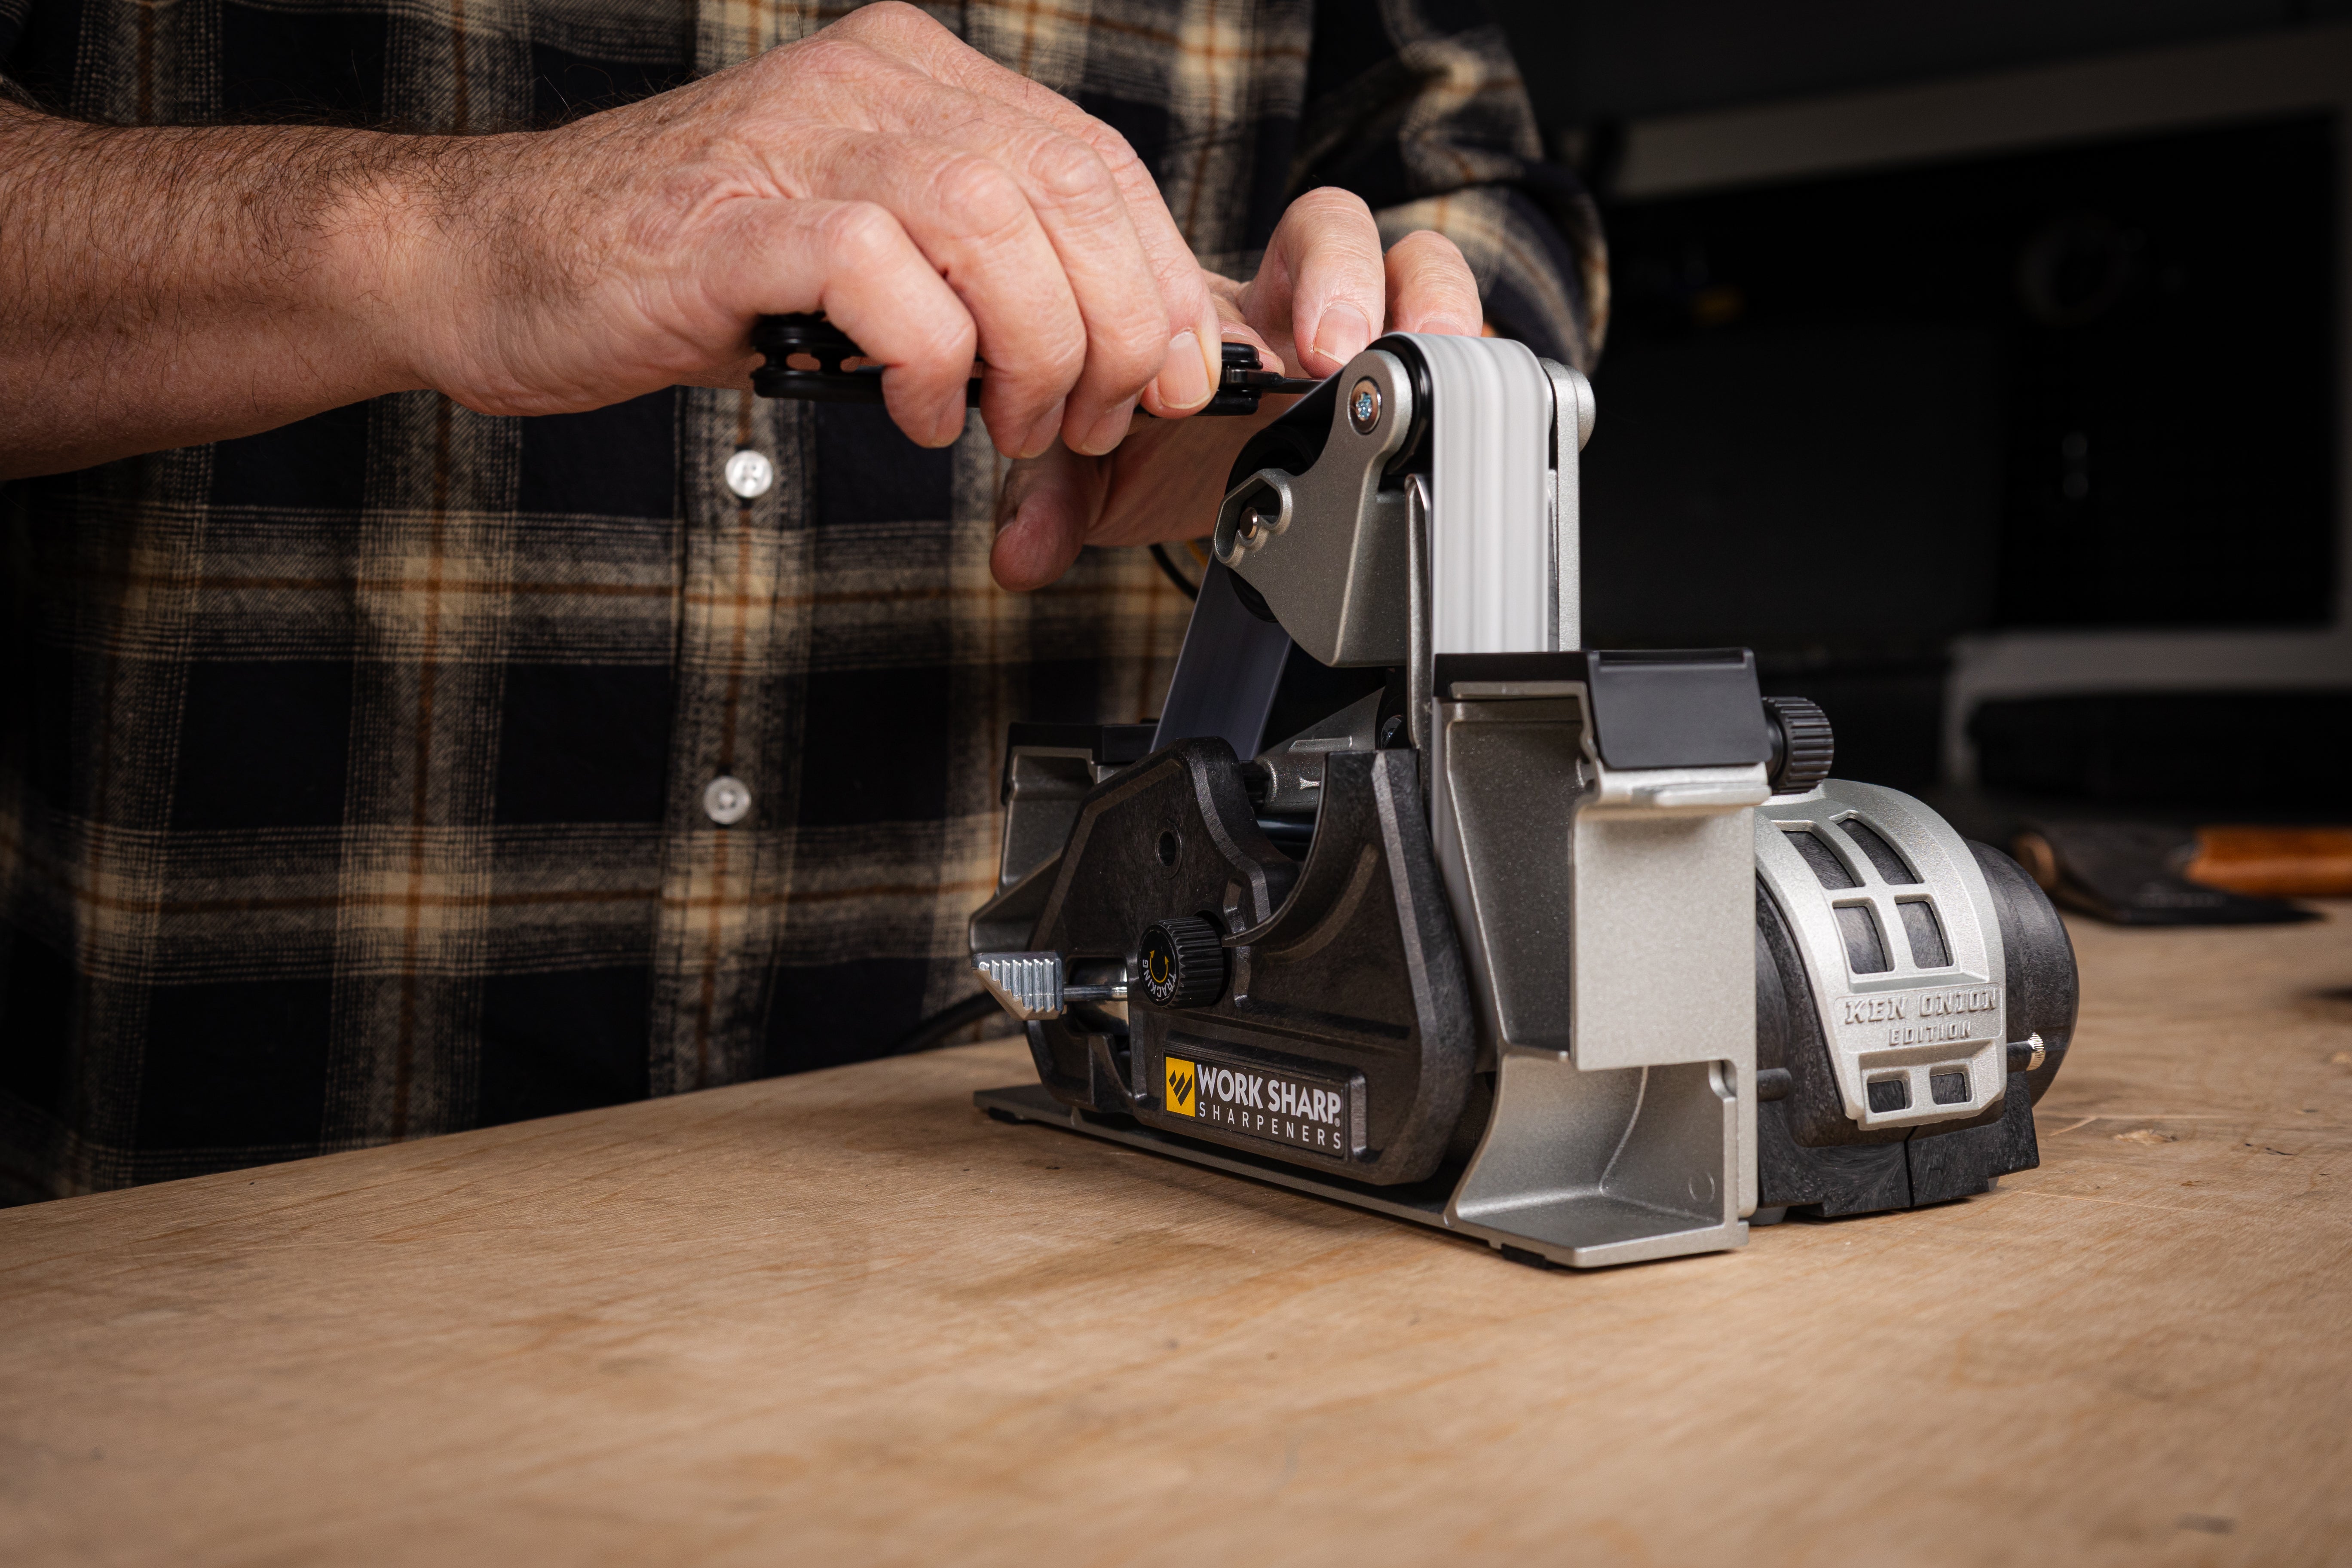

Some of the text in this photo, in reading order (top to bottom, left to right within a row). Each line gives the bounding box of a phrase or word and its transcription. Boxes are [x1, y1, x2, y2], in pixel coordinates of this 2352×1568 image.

[1143, 959, 1176, 997] TRACKING
[1845, 988, 1997, 1024] KEN ONION
[1889, 1020, 1971, 1045] EDITION
[1197, 1064, 1263, 1109] WORK
[1199, 1102, 1341, 1149] SHARPENERS
